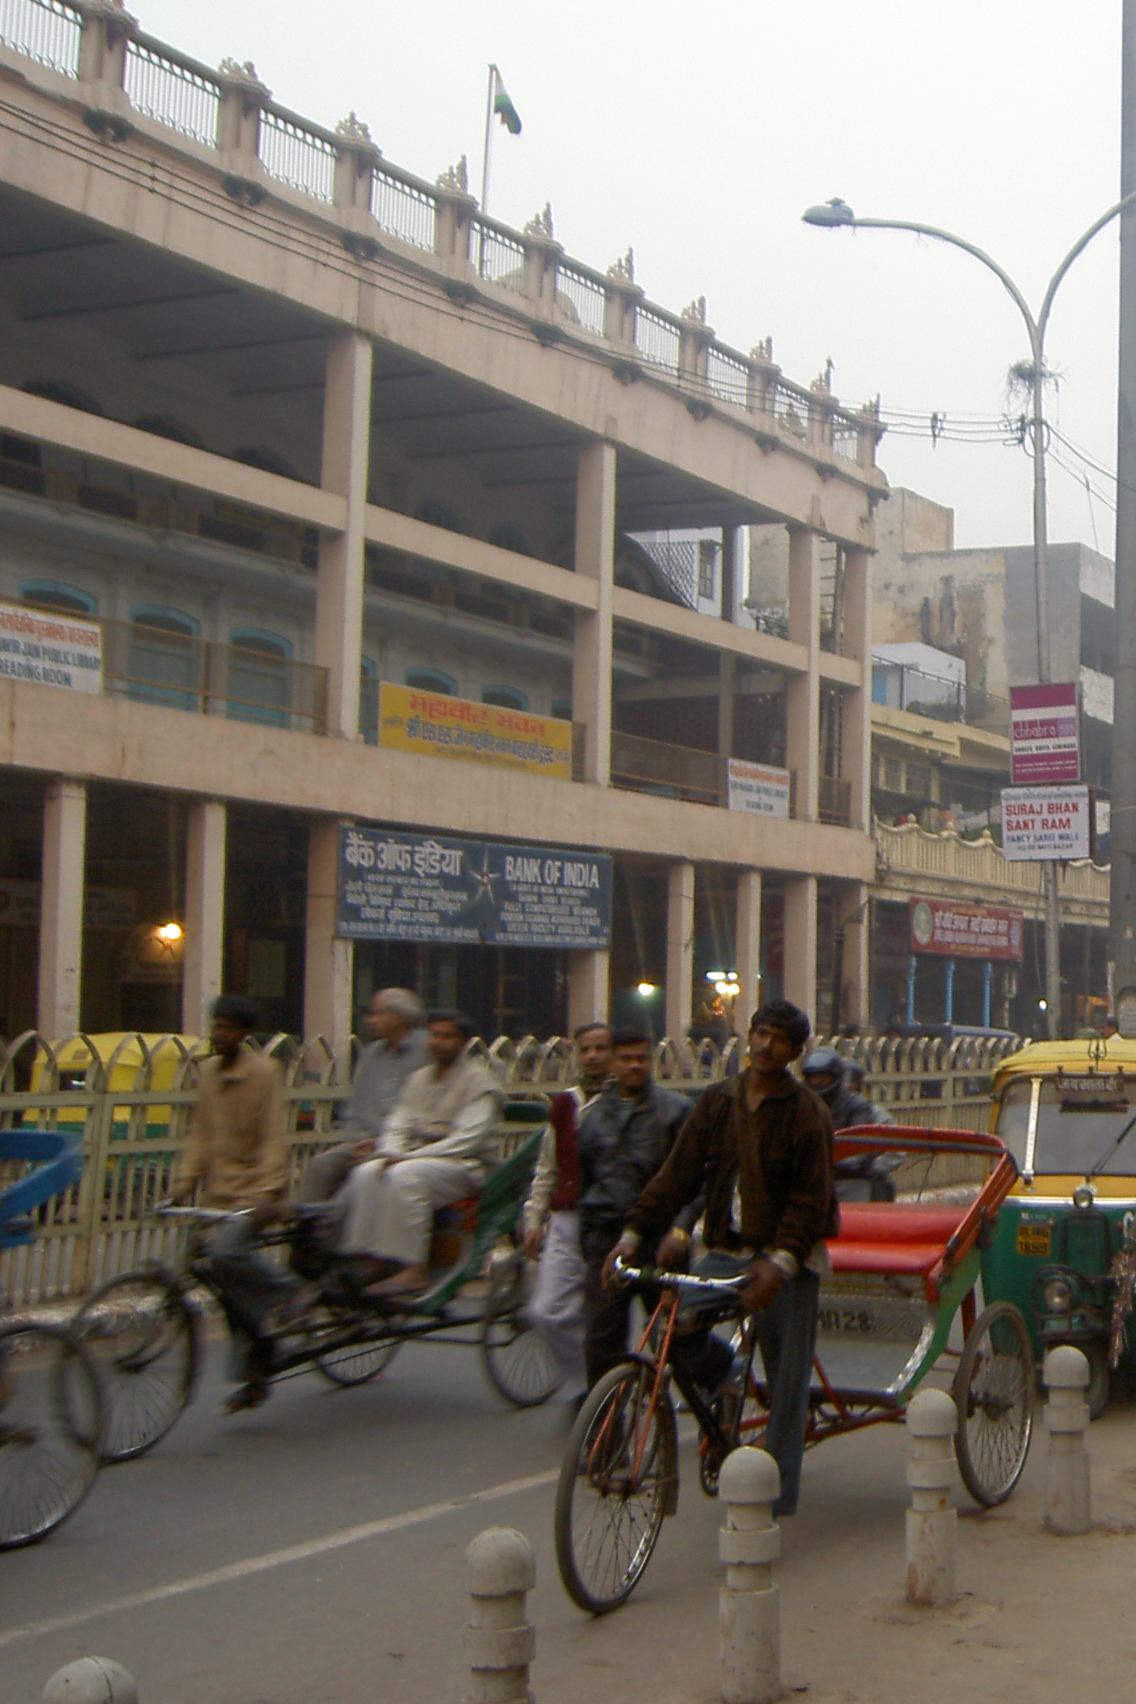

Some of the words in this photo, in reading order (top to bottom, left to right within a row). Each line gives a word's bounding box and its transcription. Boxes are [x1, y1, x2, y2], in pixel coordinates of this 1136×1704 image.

[1005, 803, 1043, 817] SURAJ
[1047, 802, 1079, 815] BHAN
[1006, 819, 1036, 832] SANT
[1041, 818, 1071, 831] RAM
[344, 831, 374, 867] बैंक
[505, 855, 542, 884] BANK
[544, 859, 562, 886] OF
[563, 861, 600, 889] INDIA
